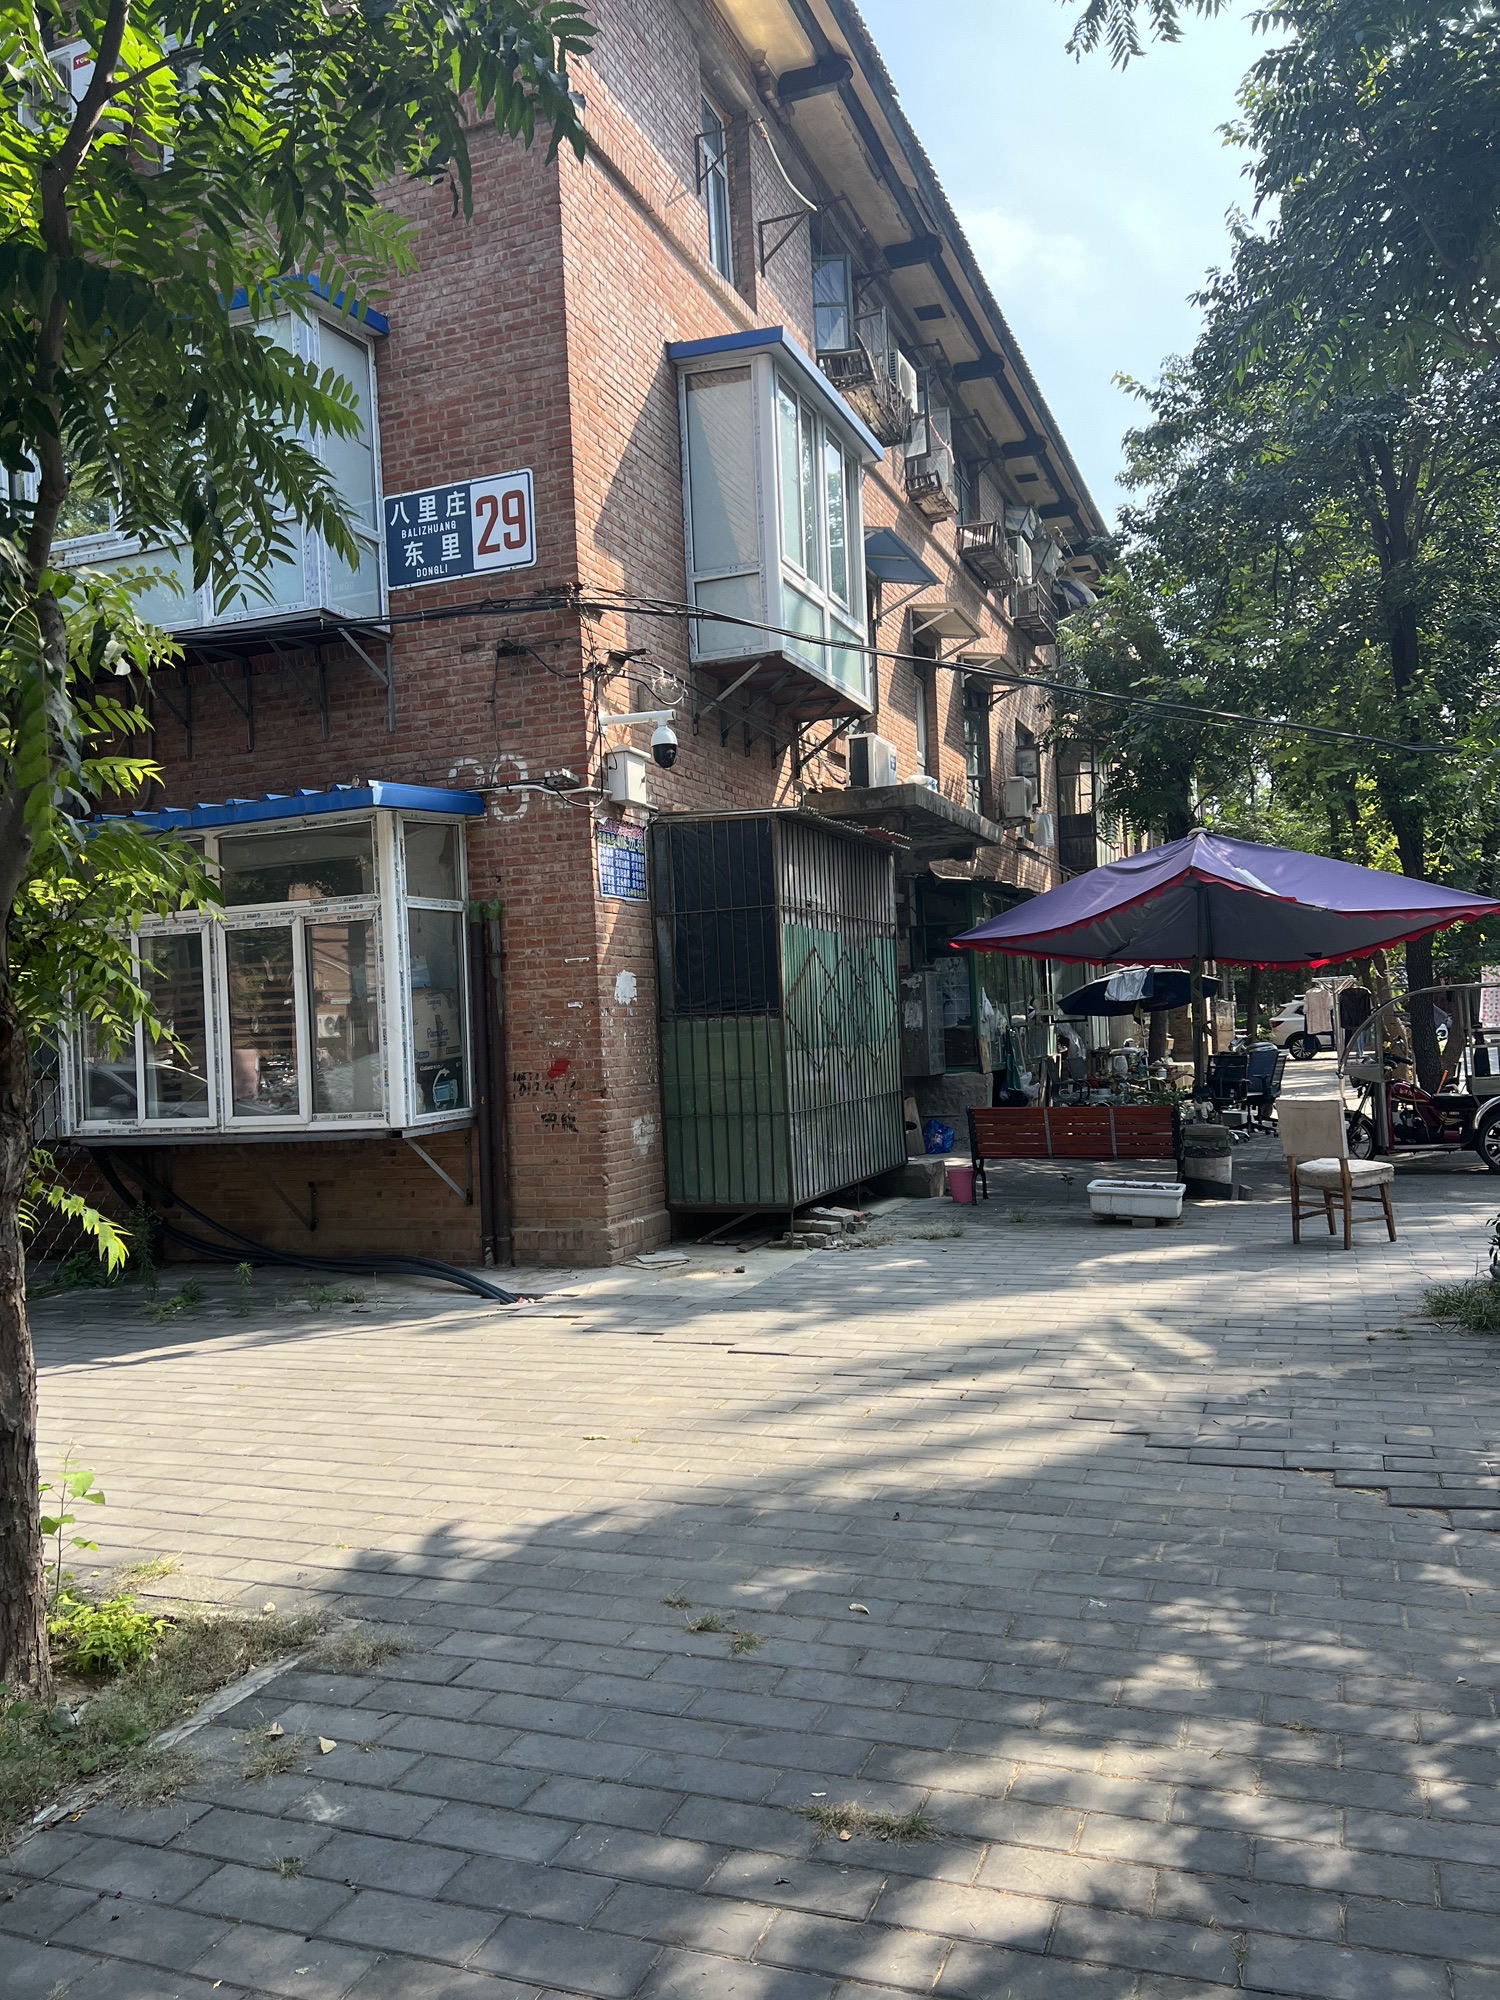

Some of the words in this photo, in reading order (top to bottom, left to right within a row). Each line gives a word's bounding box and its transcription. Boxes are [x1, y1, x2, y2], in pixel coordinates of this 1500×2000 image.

[390, 490, 466, 526] 八里庄
[475, 489, 527, 556] 29
[401, 520, 457, 539] BALIZHUANG
[403, 532, 462, 567] 东里
[416, 564, 448, 578] DONGLI
